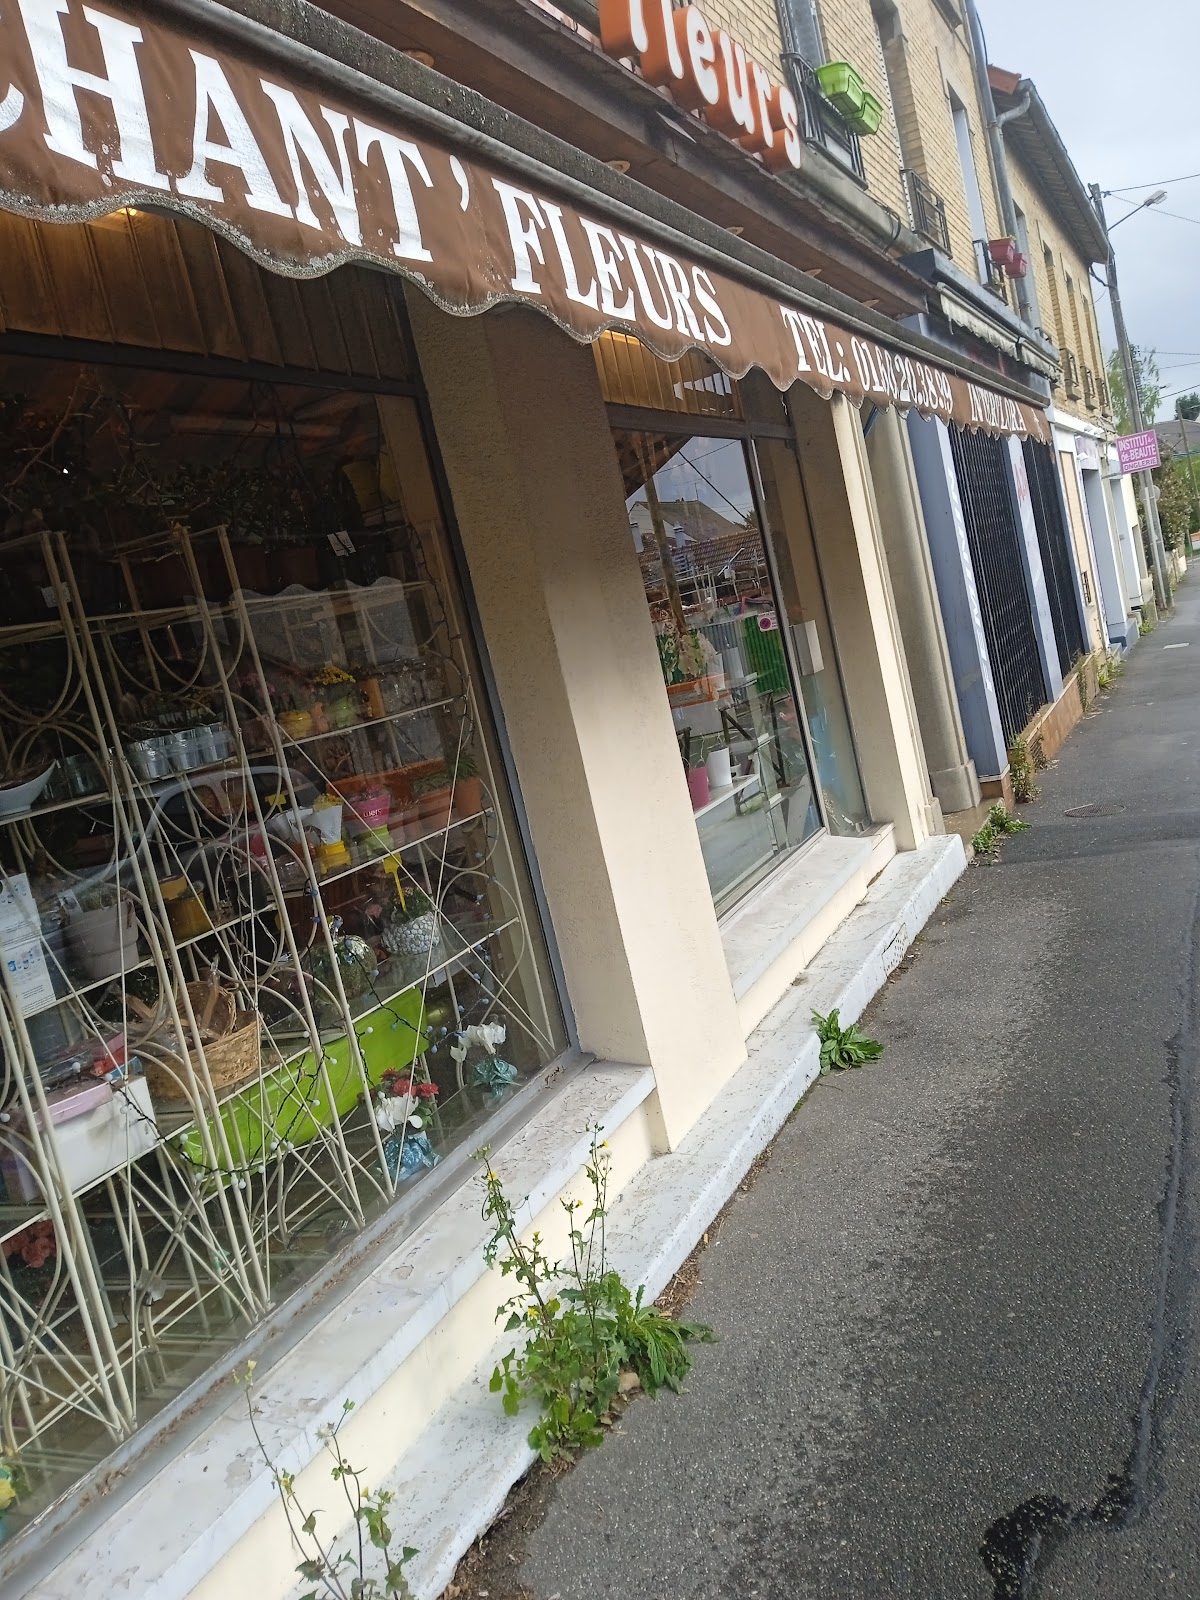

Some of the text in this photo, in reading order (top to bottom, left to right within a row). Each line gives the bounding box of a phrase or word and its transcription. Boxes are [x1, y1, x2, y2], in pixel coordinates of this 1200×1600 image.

[491, 177, 732, 347] FLEURS
[780, 305, 851, 383] TEL:
[1118, 435, 1148, 451] INSTITUT
[1124, 458, 1157, 470] ONGLERIE
